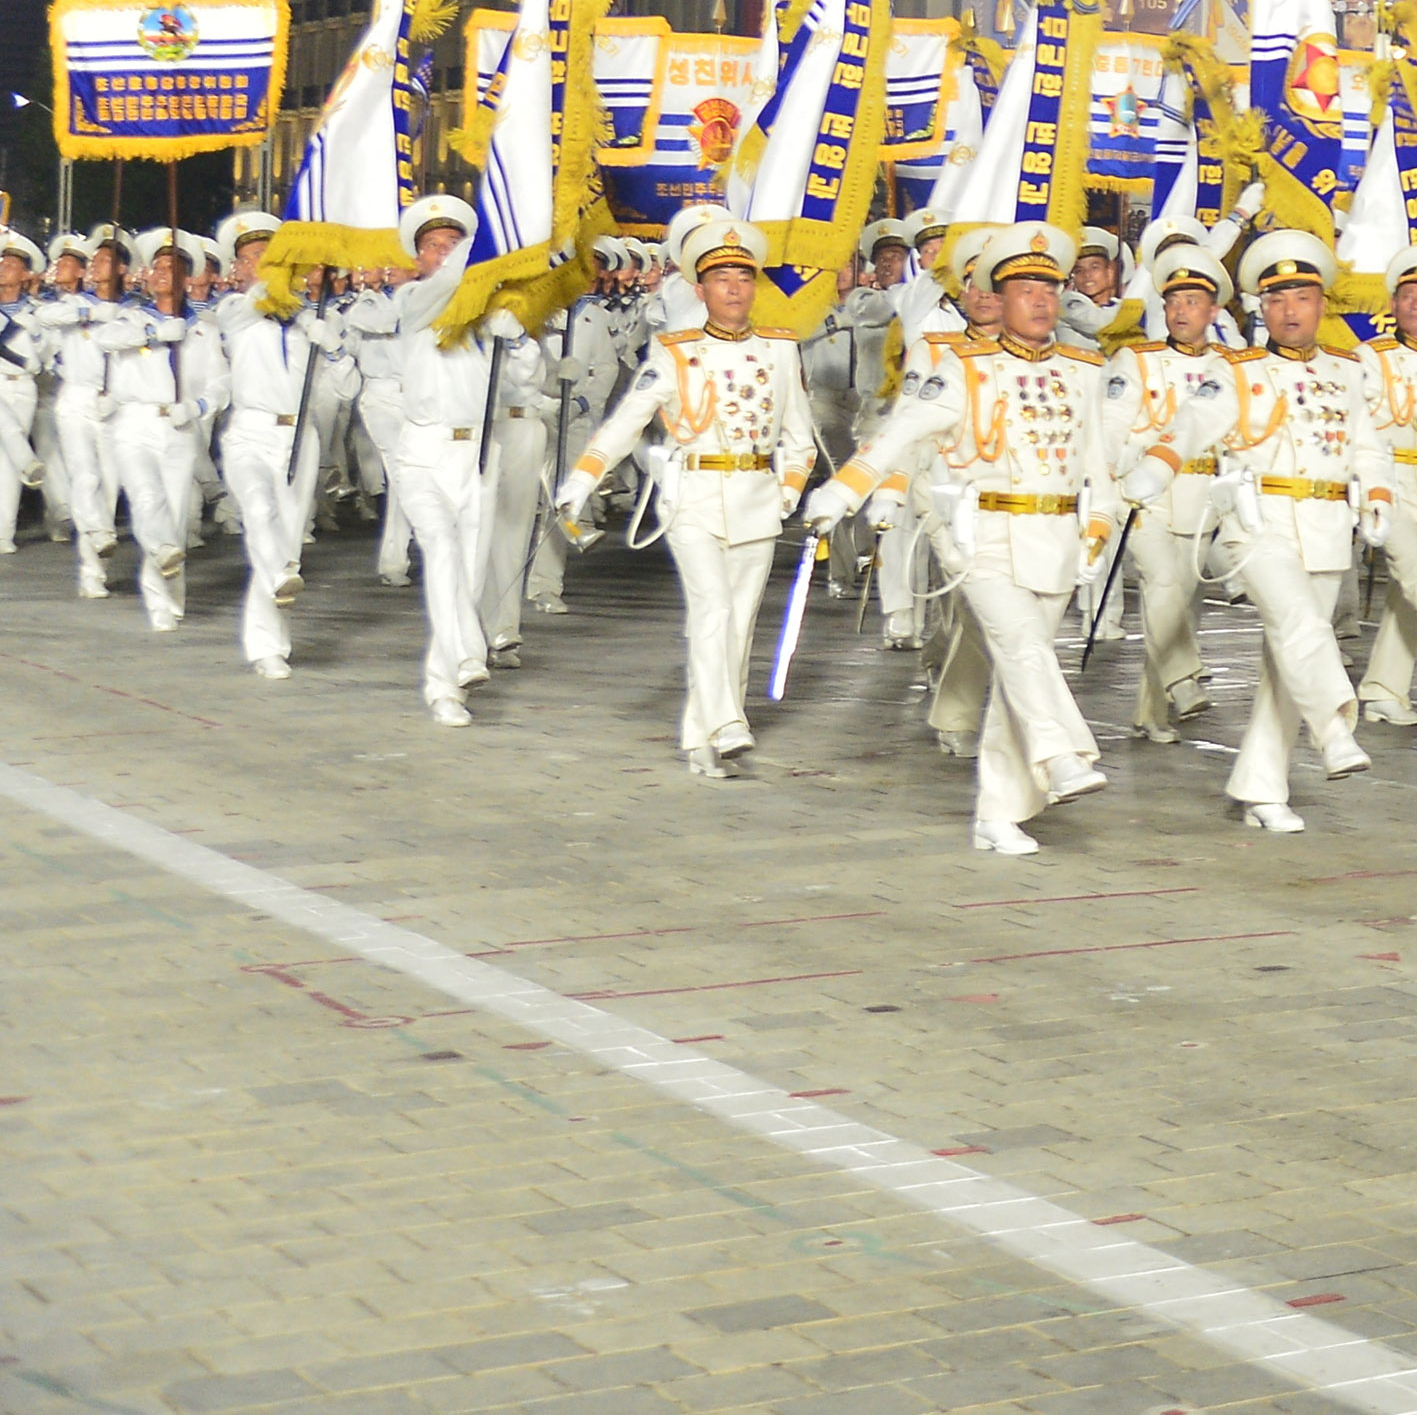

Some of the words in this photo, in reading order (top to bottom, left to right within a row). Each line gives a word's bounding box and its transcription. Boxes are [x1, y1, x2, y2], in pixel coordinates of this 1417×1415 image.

[832, 4, 871, 91] 무궁한
[1033, 15, 1068, 98] 무궁한
[806, 112, 855, 201] 번영과
[1017, 122, 1057, 205] 번영과
